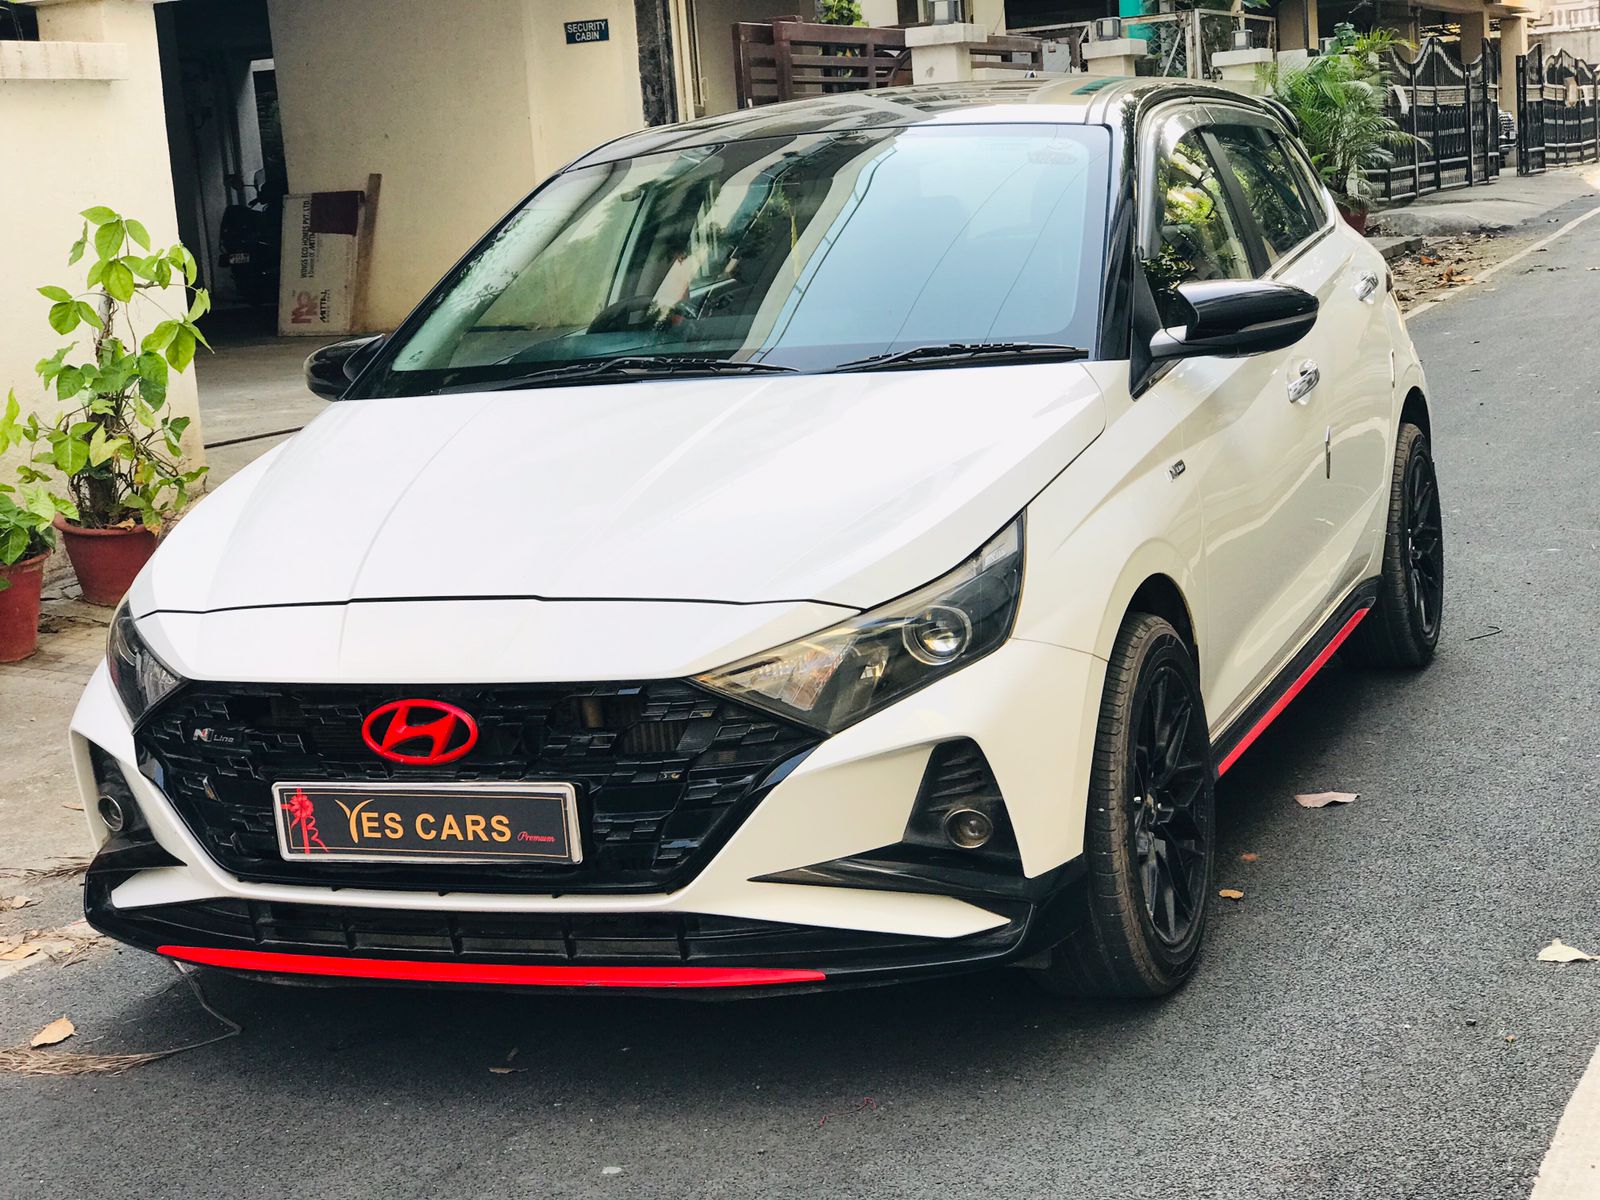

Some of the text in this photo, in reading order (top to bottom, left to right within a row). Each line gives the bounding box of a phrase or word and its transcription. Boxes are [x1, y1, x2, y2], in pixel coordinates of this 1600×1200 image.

[567, 21, 606, 33] SECURITY
[575, 31, 600, 41] CABIN
[335, 799, 512, 843] YES CARS
